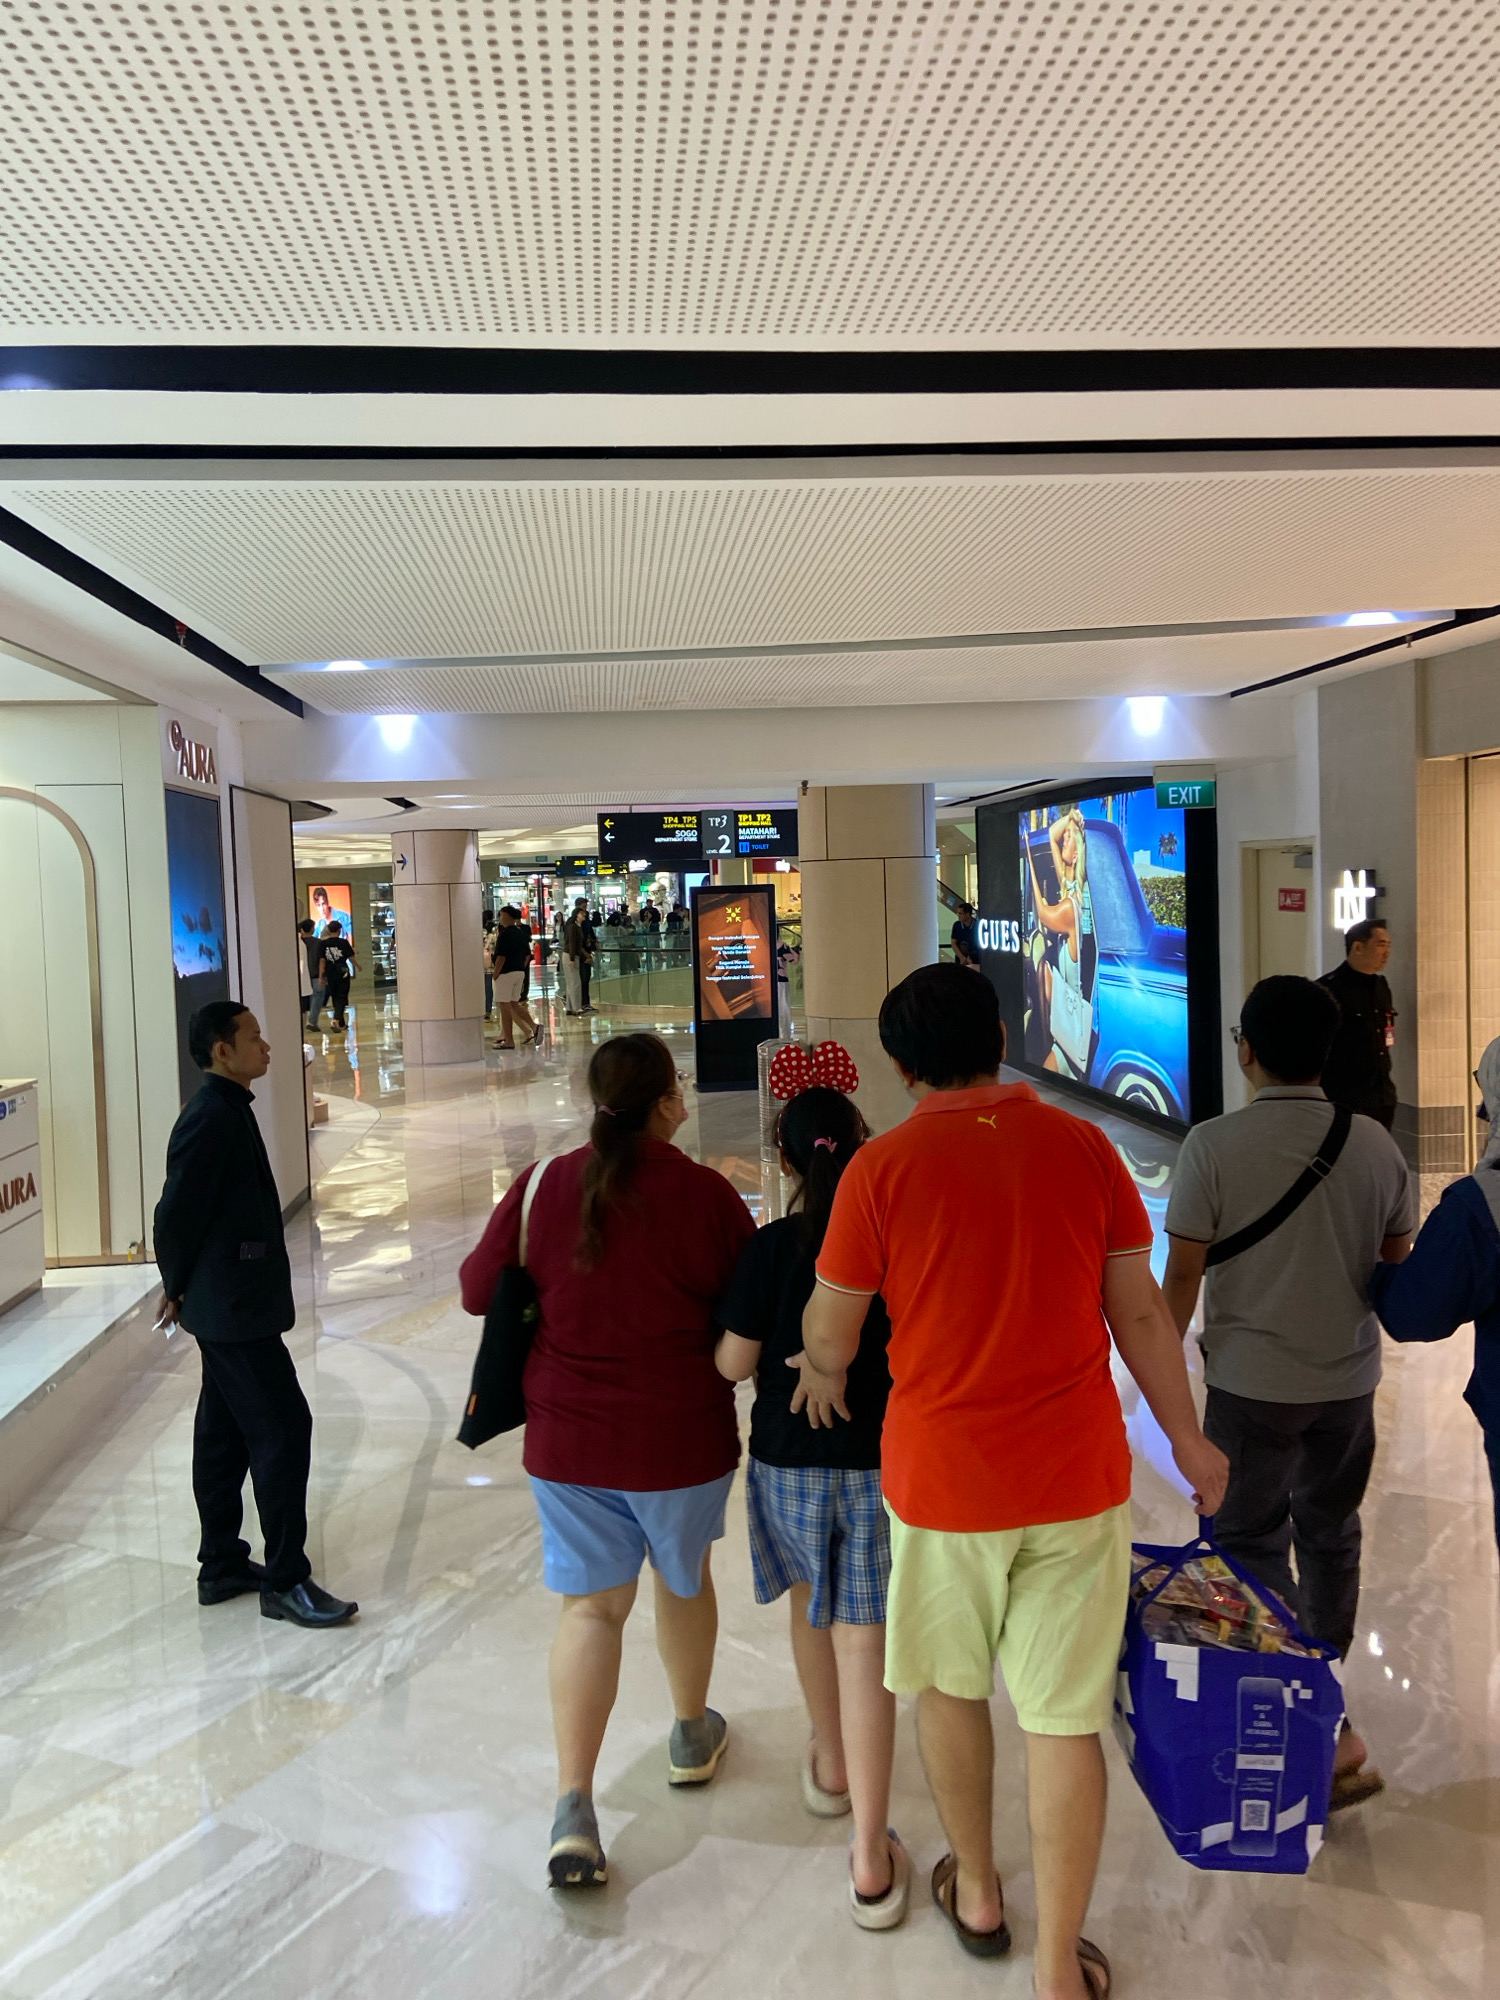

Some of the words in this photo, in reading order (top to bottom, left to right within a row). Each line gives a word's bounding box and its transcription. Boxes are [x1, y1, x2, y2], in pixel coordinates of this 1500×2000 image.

[178, 737, 217, 784] AURA
[1168, 786, 1202, 805] EXIT
[663, 816, 678, 824] TP4
[682, 815, 697, 824] TP5
[708, 814, 728, 828] TP3
[738, 814, 752, 822] TP1
[756, 813, 772, 821] TP2
[675, 829, 698, 837] SOGO
[738, 827, 777, 835] MATAHARI
[717, 834, 732, 854] 2
